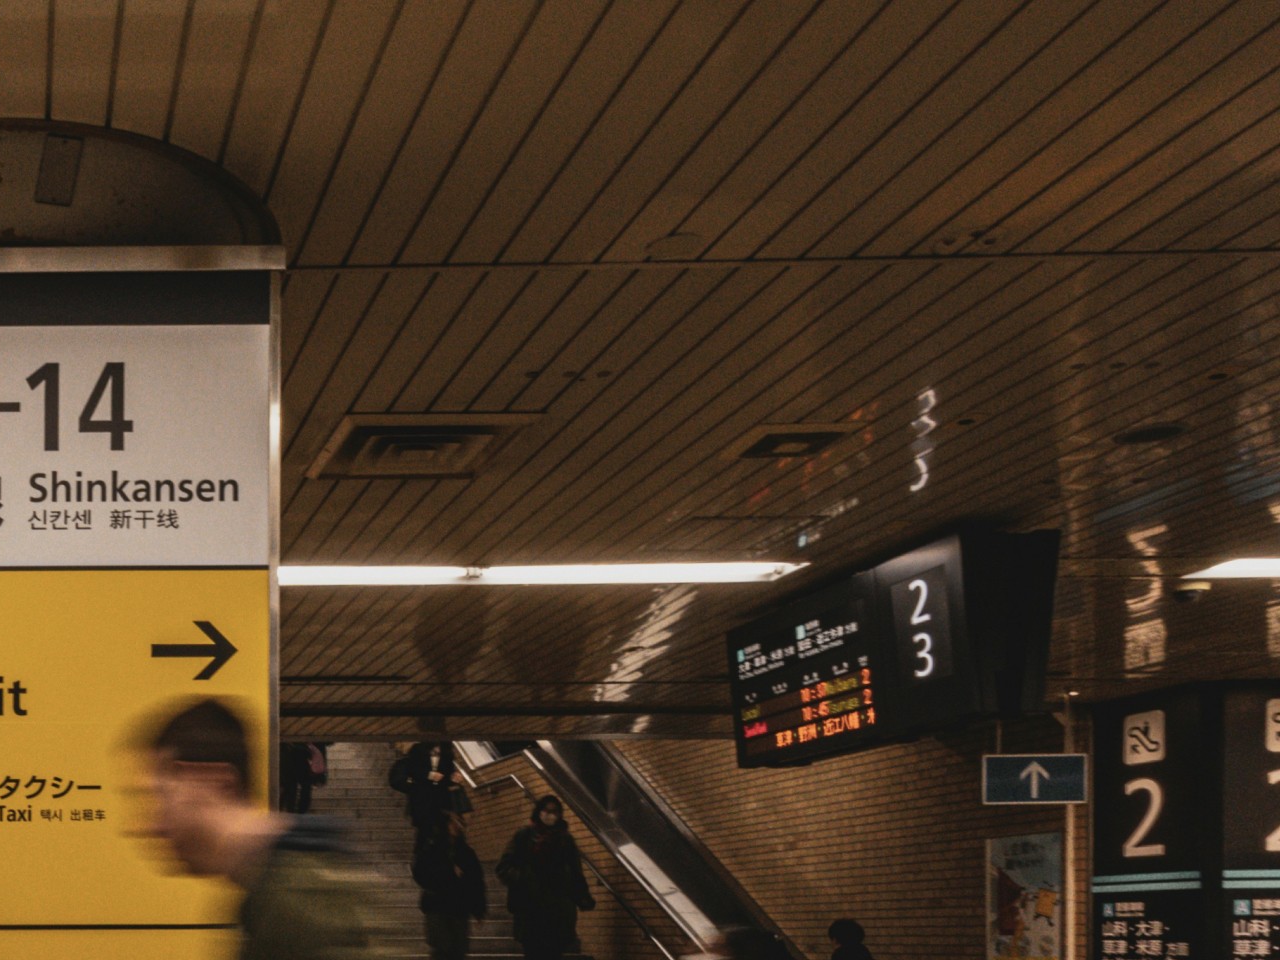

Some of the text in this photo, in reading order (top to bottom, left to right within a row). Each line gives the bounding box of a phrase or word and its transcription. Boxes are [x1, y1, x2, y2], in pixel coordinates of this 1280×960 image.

[29, 470, 239, 503] Shinkansen
[27, 509, 92, 531] 신칸센
[109, 509, 180, 530] 新干线
[908, 580, 931, 625] 2
[913, 633, 934, 678] 3
[70, 808, 106, 822] 出租车
[1122, 777, 1166, 858] 2
